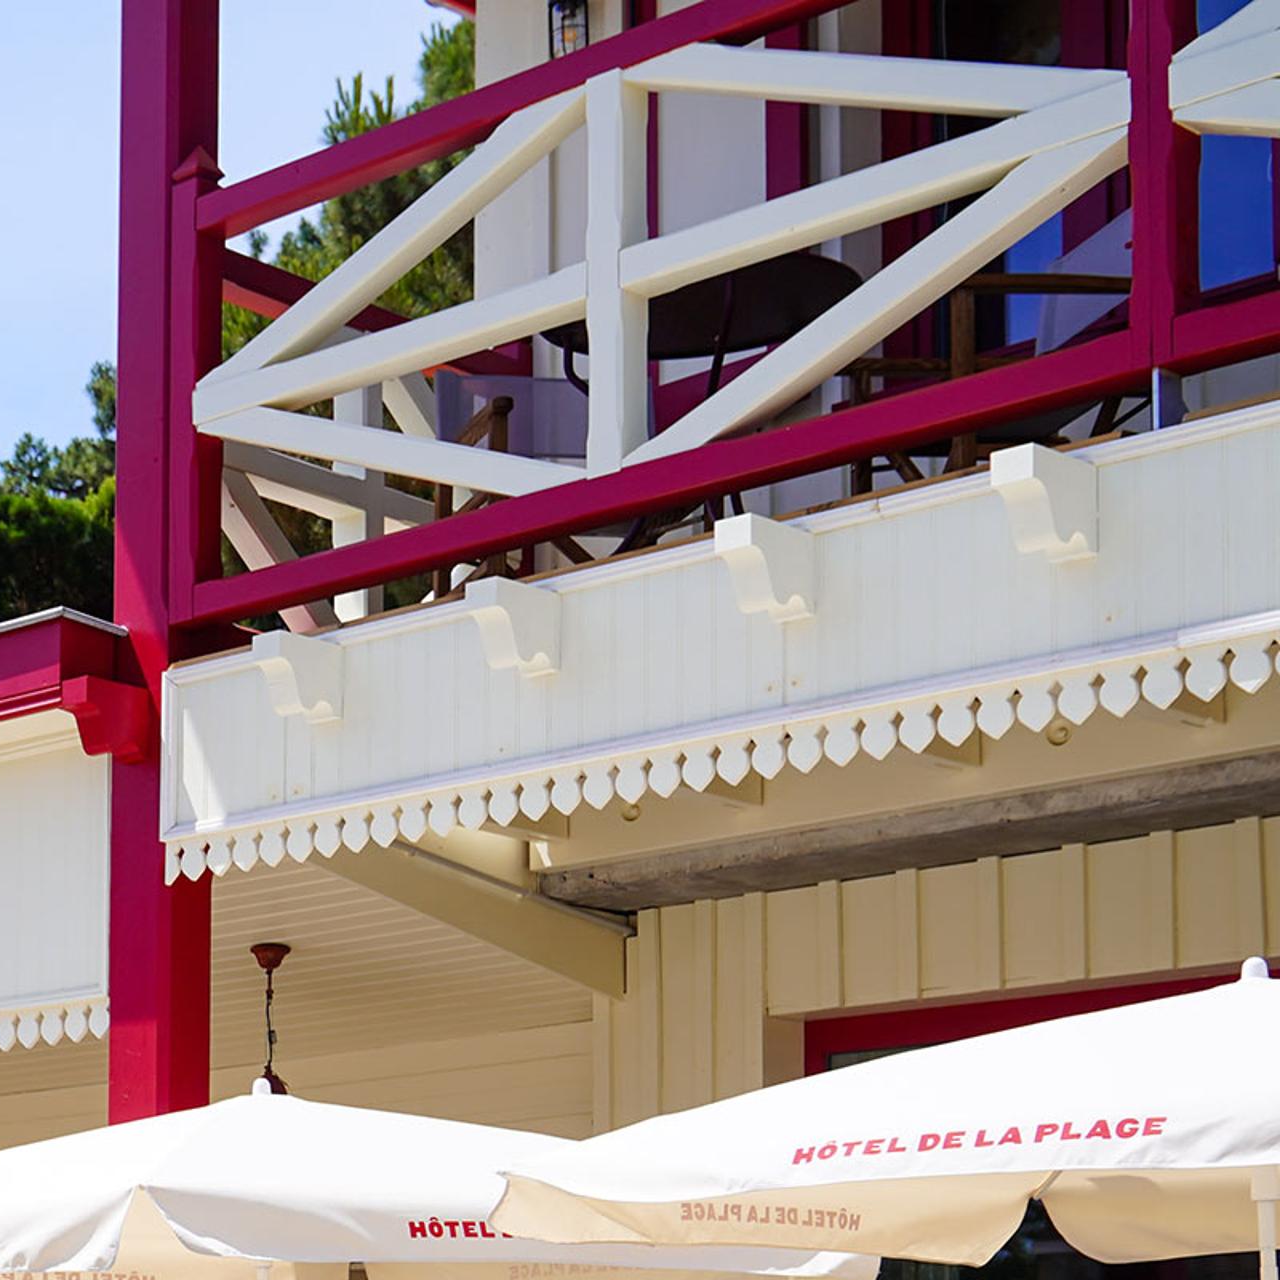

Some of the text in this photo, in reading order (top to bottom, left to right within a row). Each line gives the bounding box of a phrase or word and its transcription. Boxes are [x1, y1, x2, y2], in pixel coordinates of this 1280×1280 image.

[792, 1117, 1168, 1165] HÔTEL DE LA PLAGE
[409, 1216, 496, 1239] HÔTEL
